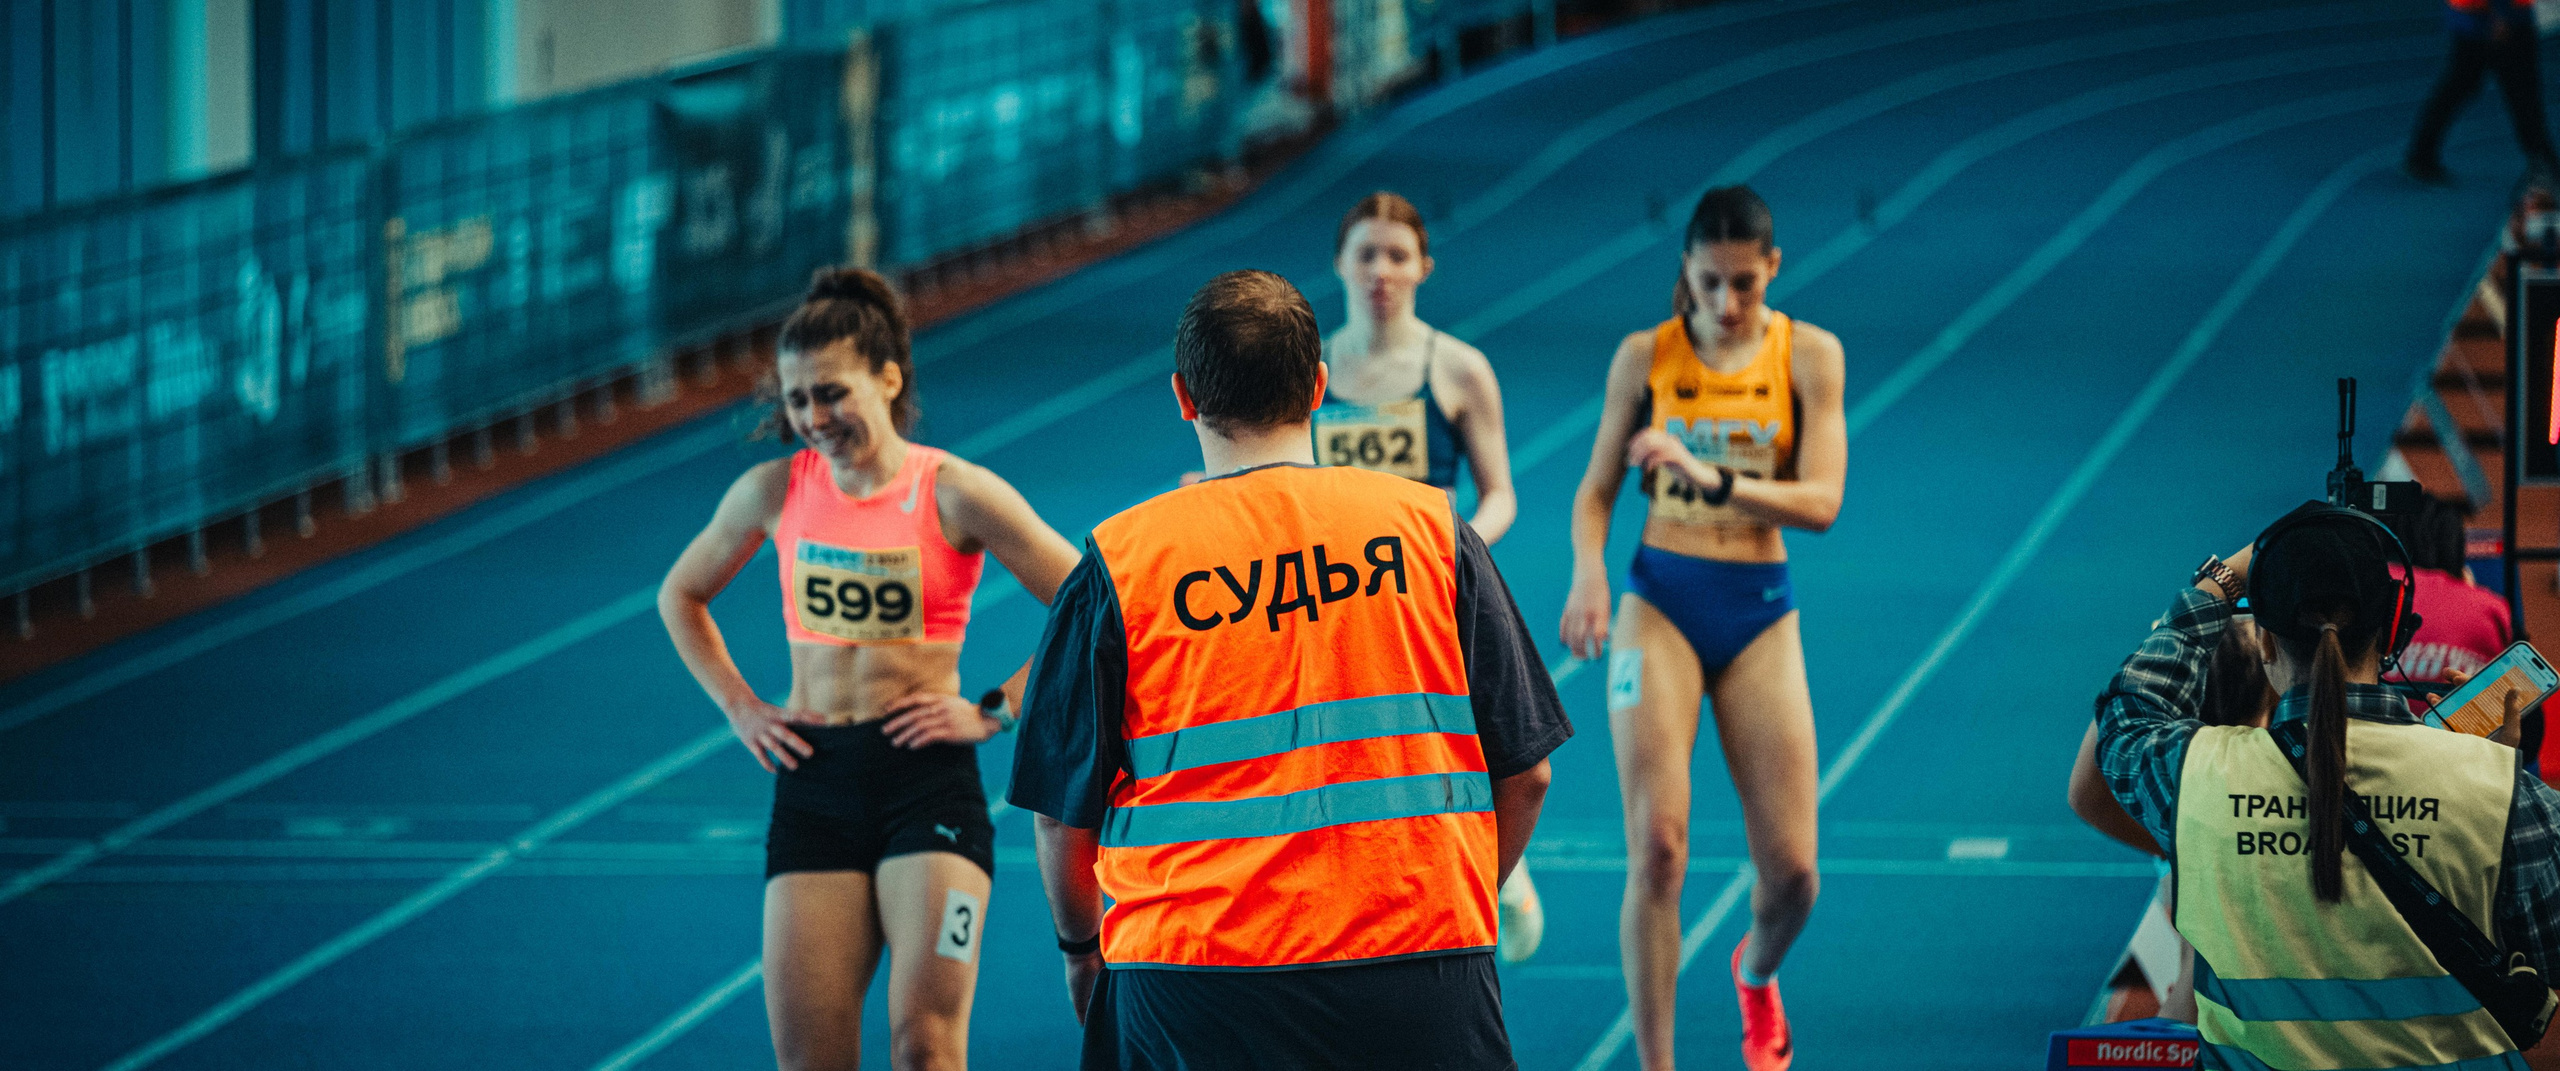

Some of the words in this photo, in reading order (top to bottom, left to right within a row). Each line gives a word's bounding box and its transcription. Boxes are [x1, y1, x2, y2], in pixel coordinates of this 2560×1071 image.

[1329, 428, 1413, 467] 562
[806, 576, 913, 624] 599
[1173, 536, 1408, 632] СУДЬЯ
[2228, 794, 2440, 824] ТРАНЦИЯ
[2236, 831, 2431, 859] BROST
[951, 904, 972, 948] 3
